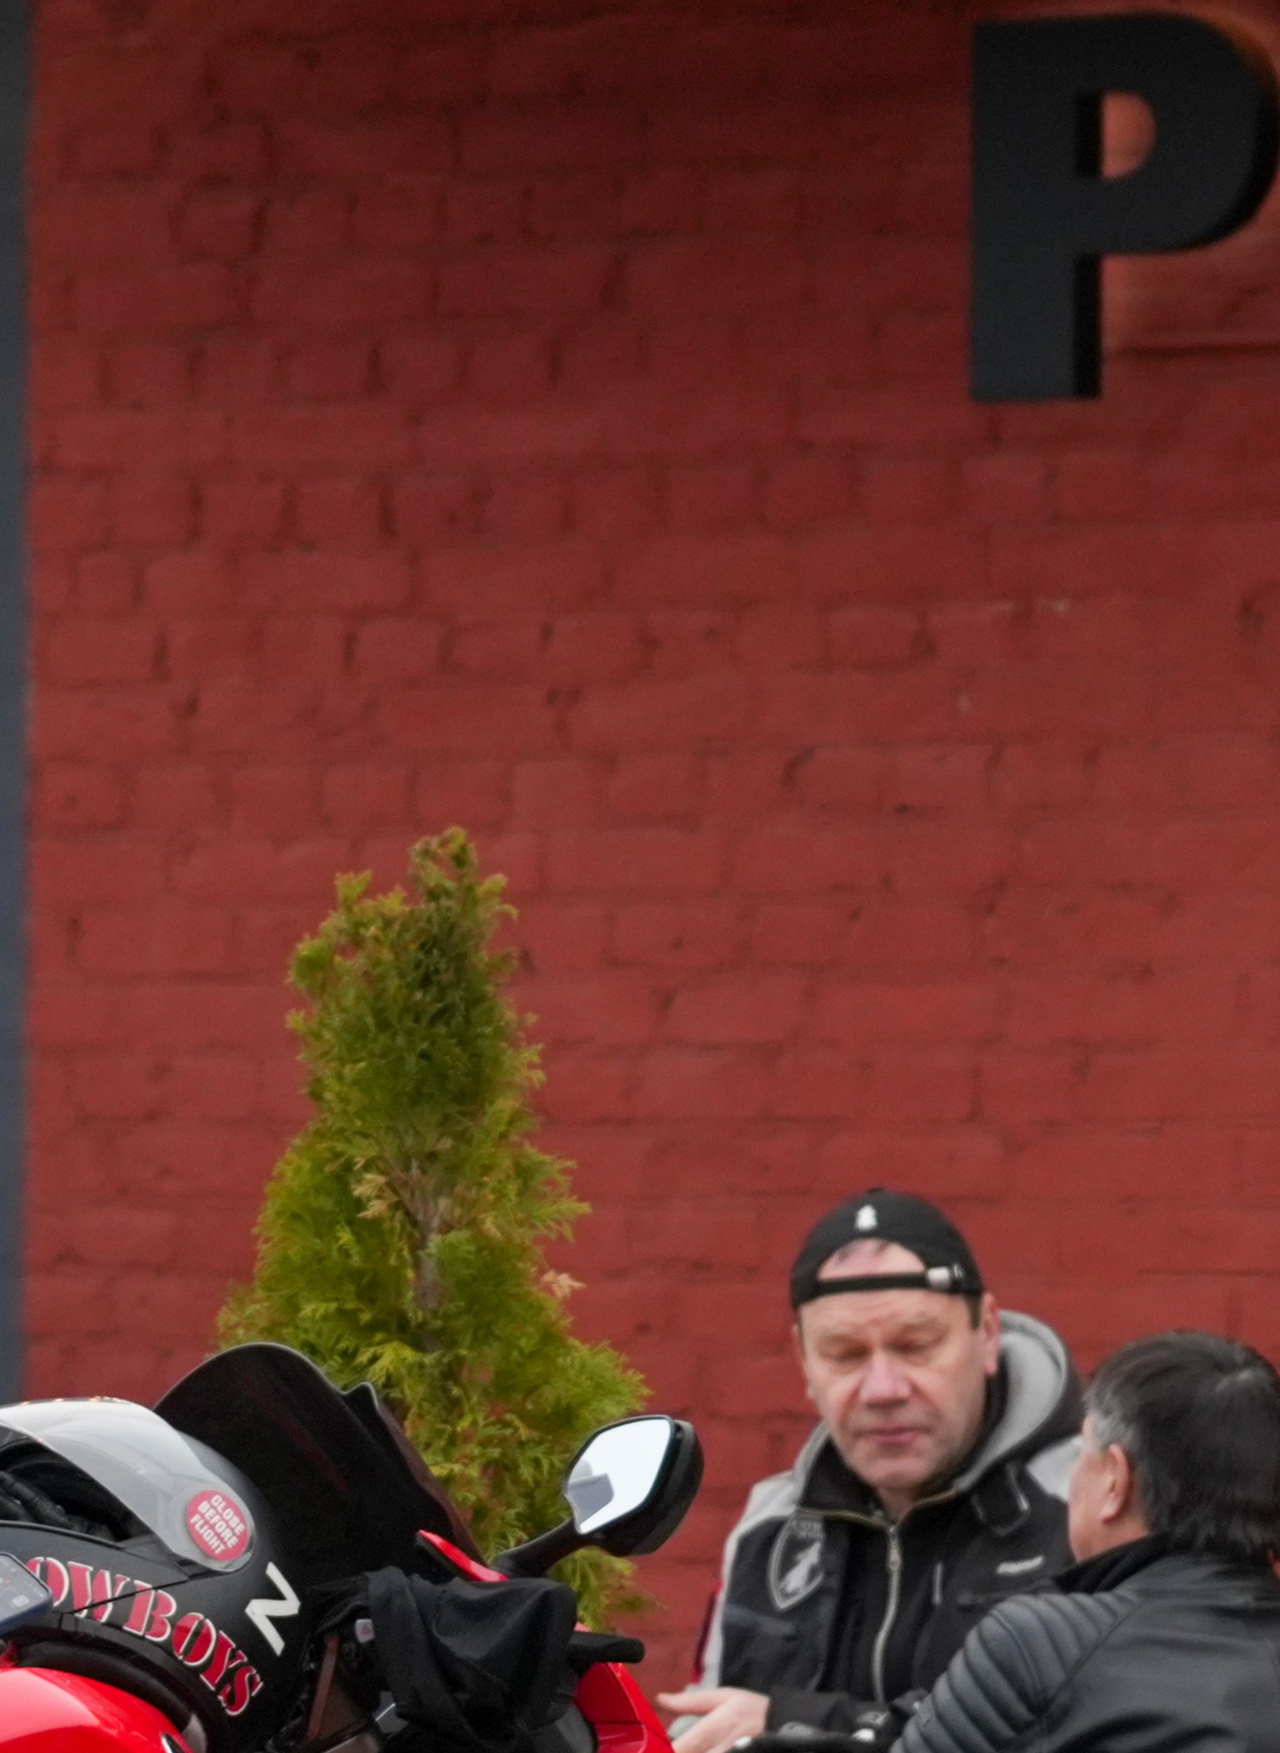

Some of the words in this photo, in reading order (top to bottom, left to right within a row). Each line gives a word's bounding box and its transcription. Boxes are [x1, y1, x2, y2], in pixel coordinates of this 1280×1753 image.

[189, 1514, 226, 1554] FLIGHT
[198, 1500, 239, 1549] BEFORE
[210, 1494, 246, 1536] CLOSE
[25, 1556, 264, 1716] OWBOYS
